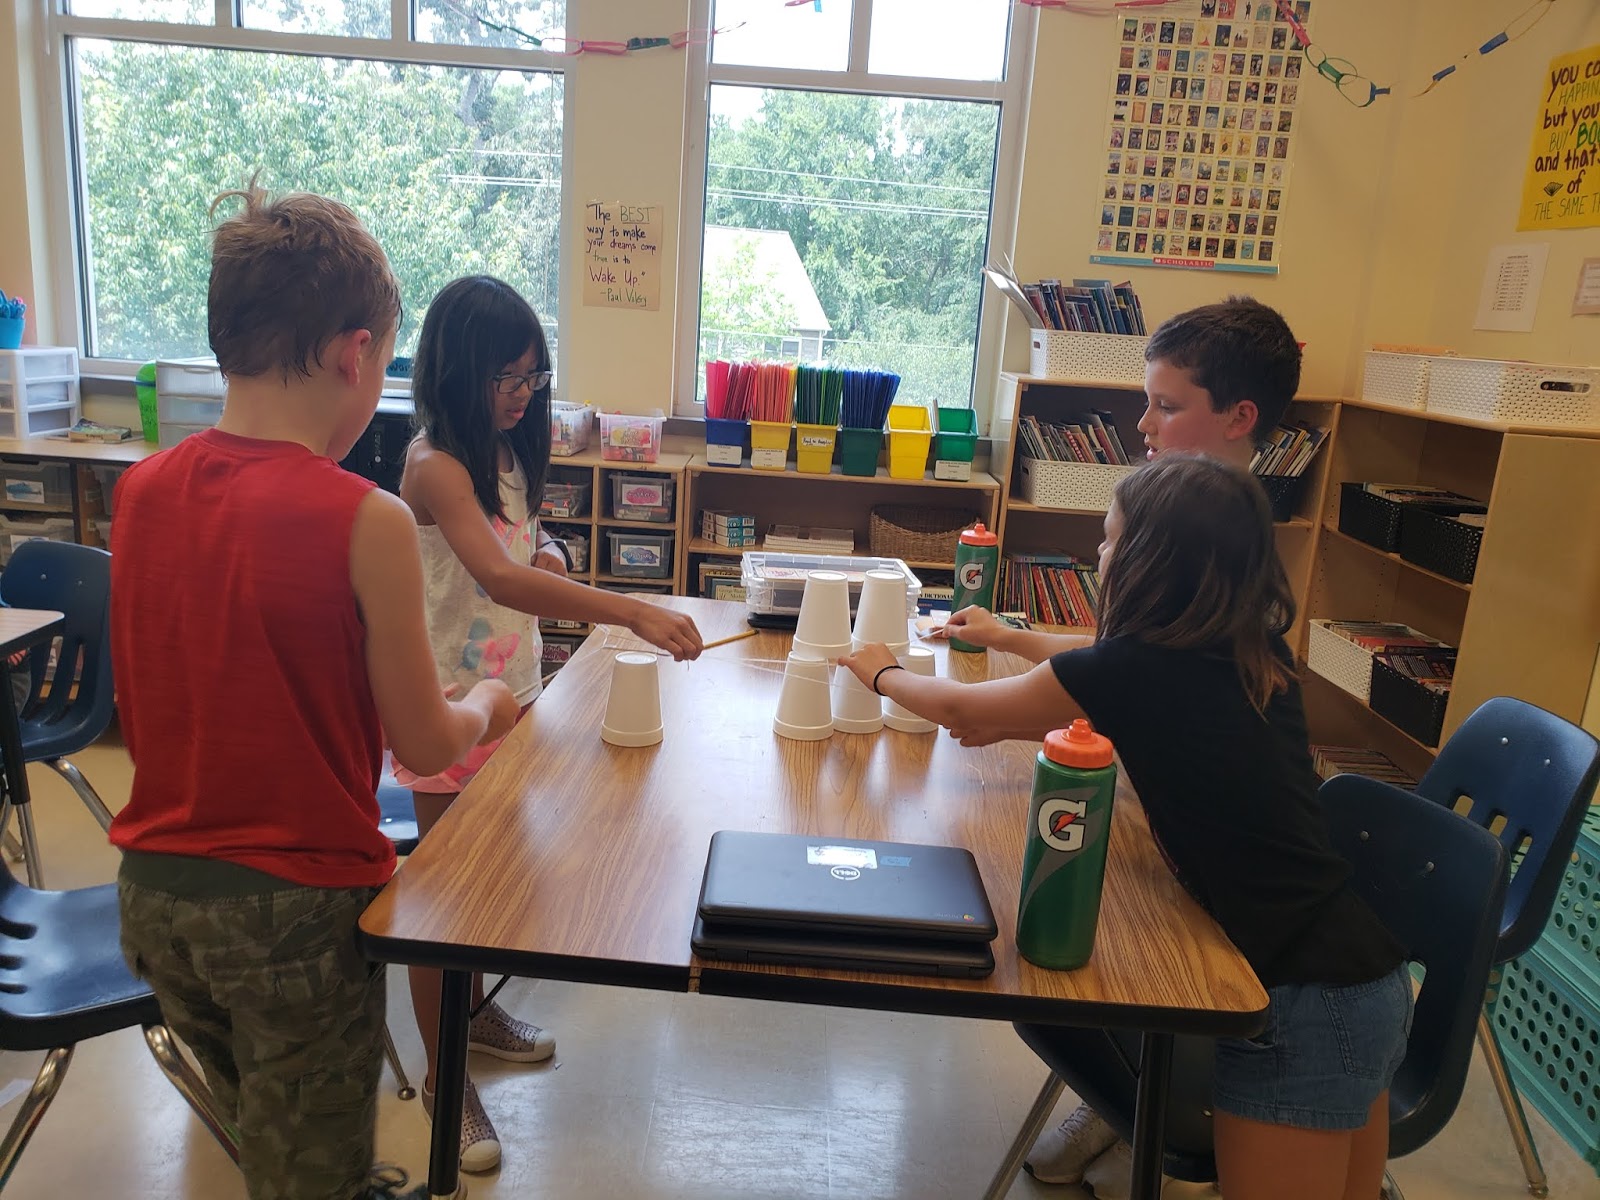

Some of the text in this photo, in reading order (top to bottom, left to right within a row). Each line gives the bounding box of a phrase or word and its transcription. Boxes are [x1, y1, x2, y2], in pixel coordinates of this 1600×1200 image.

[1548, 64, 1580, 103] you
[1543, 105, 1568, 130] but
[1549, 129, 1569, 153] BUY
[1535, 151, 1560, 173] and
[1567, 168, 1586, 195] of
[586, 202, 656, 226] The BEST
[1534, 200, 1553, 222] THE
[1558, 195, 1589, 218] SAME
[586, 225, 647, 241] way to make
[586, 239, 657, 255] your dreams come
[612, 255, 619, 264] is
[623, 254, 631, 264] to
[1161, 258, 1213, 267] SCHOLASTIC
[588, 265, 617, 285] Wake
[960, 562, 984, 591] G
[1036, 797, 1087, 852] G
